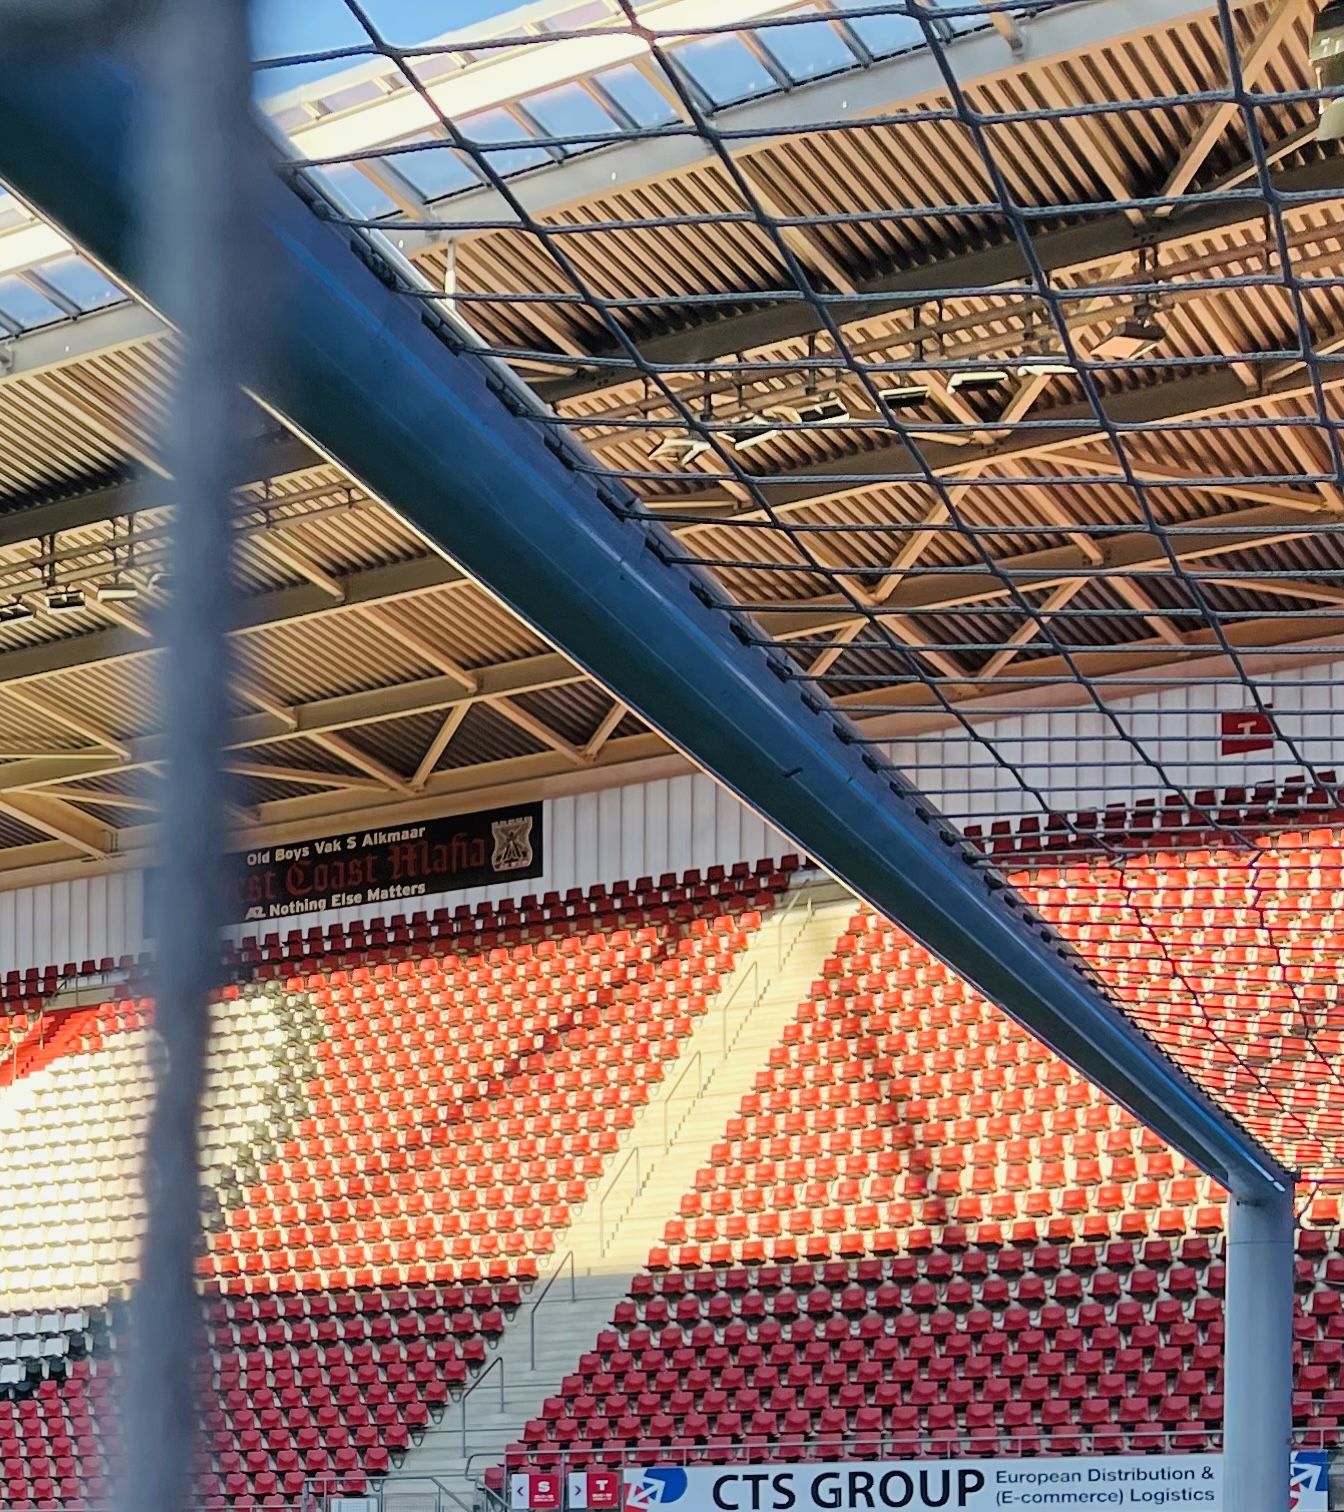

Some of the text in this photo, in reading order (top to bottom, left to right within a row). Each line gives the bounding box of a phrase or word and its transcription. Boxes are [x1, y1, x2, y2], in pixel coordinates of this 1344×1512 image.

[247, 826, 426, 865] Old Boys Vak S Alkmaar
[285, 853, 377, 897] Coast
[387, 832, 486, 881] Mafia
[269, 898, 327, 917] Nothing
[331, 890, 363, 908] Else
[367, 881, 426, 901] Matters
[538, 1481, 551, 1493] S
[595, 1479, 609, 1491] T
[996, 1466, 1215, 1485] European Distribution &
[713, 1469, 986, 1510] CTS GROUP
[995, 1487, 1215, 1506] (E-commerce) Logistics
